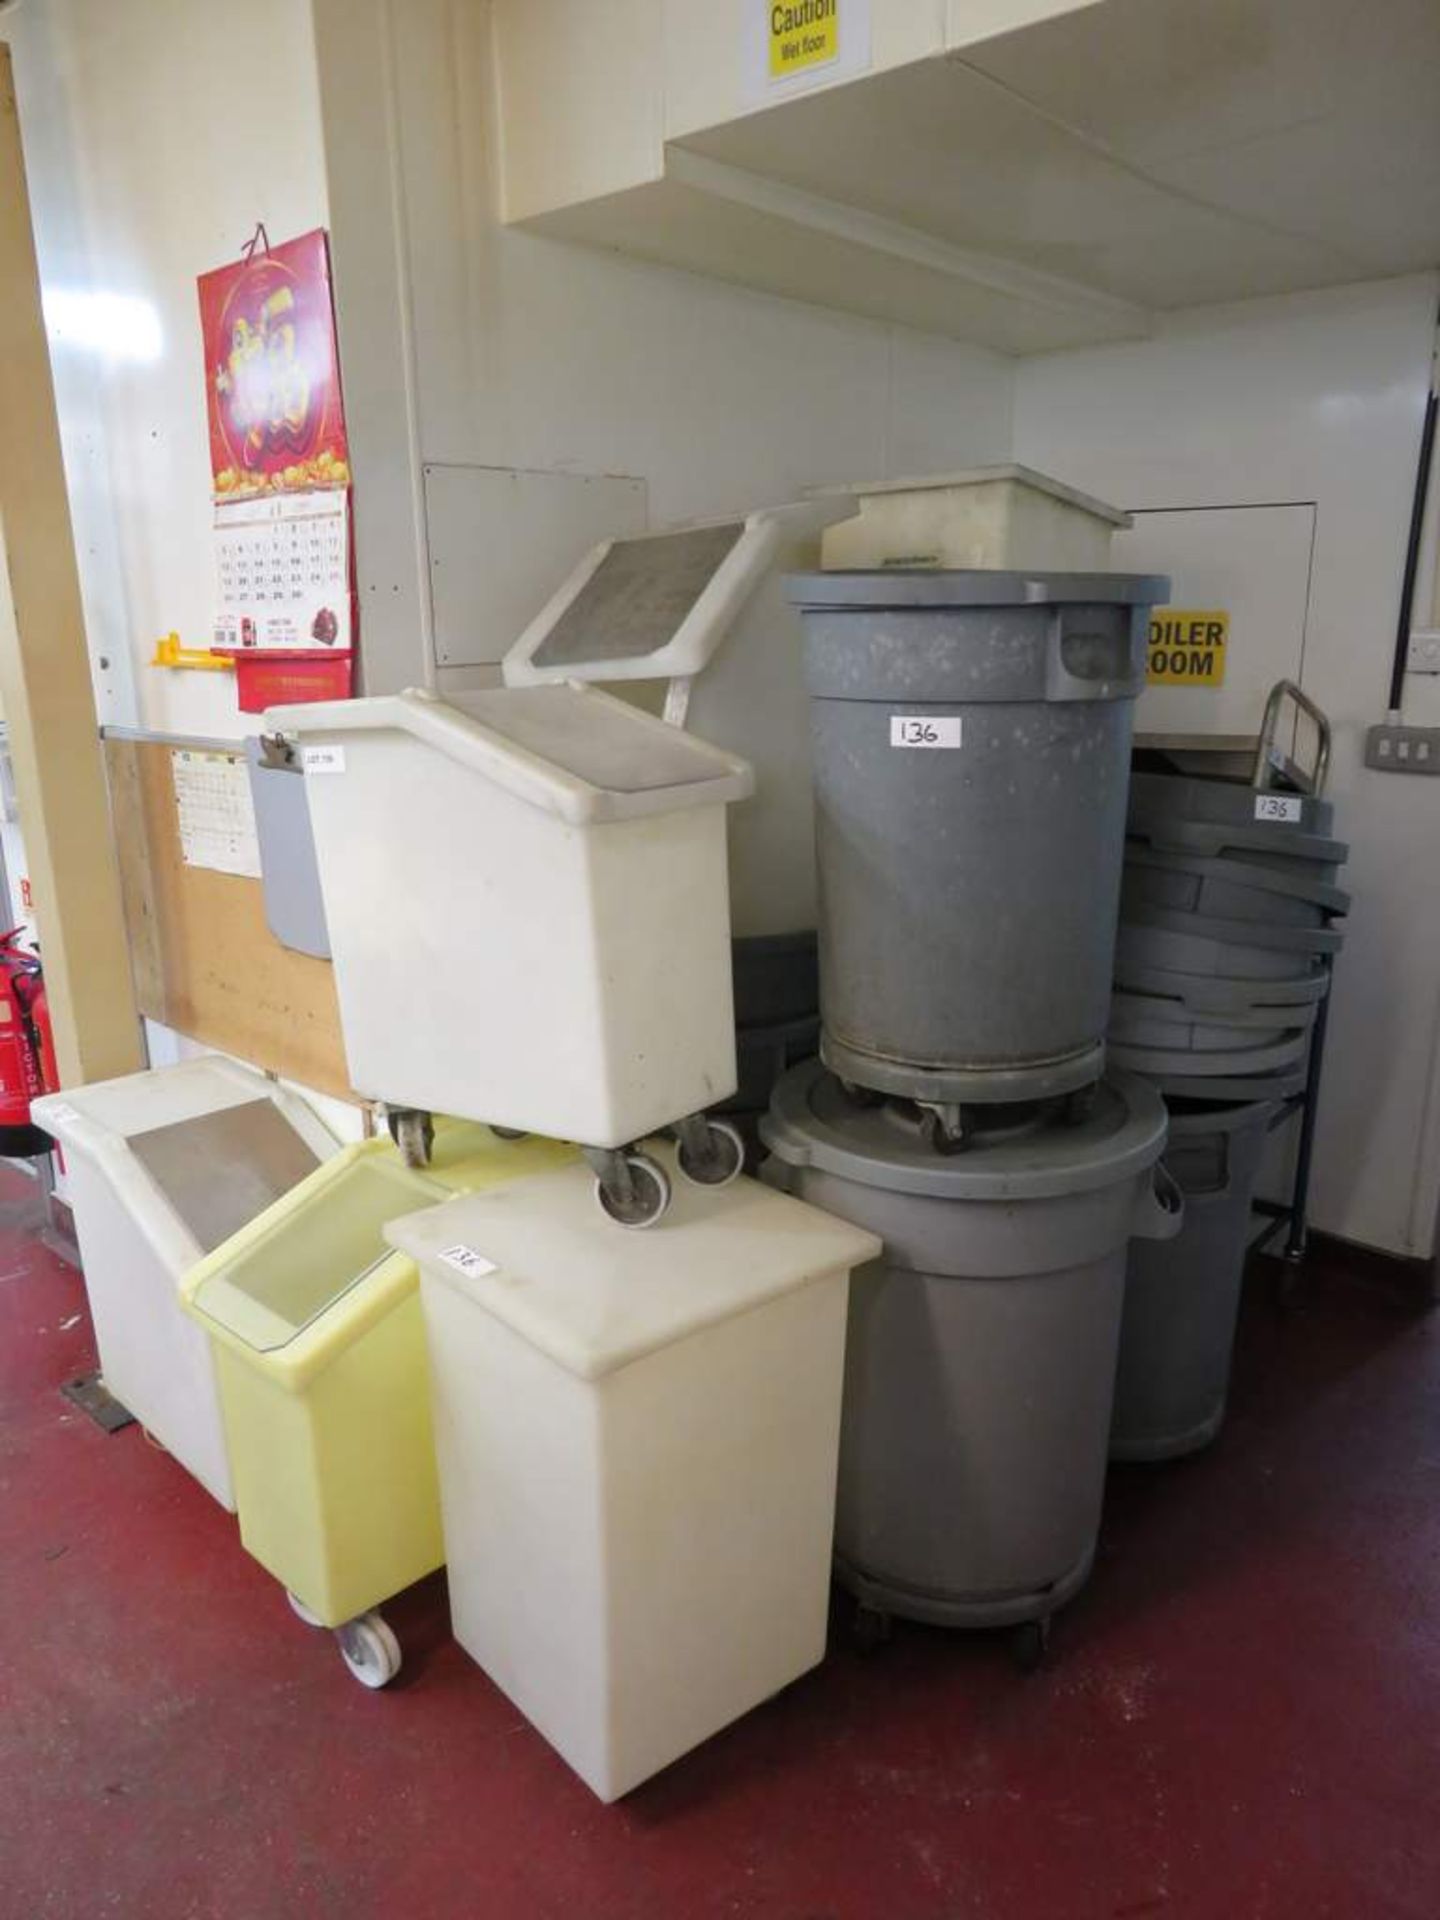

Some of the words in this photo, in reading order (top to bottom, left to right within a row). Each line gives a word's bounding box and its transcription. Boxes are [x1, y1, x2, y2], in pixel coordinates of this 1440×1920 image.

[772, 0, 836, 36] Caution
[1147, 621, 1223, 646] OILER
[1145, 649, 1214, 675] OOM
[901, 722, 938, 743] 136
[1261, 799, 1287, 818] 136
[446, 1248, 481, 1266] 136
